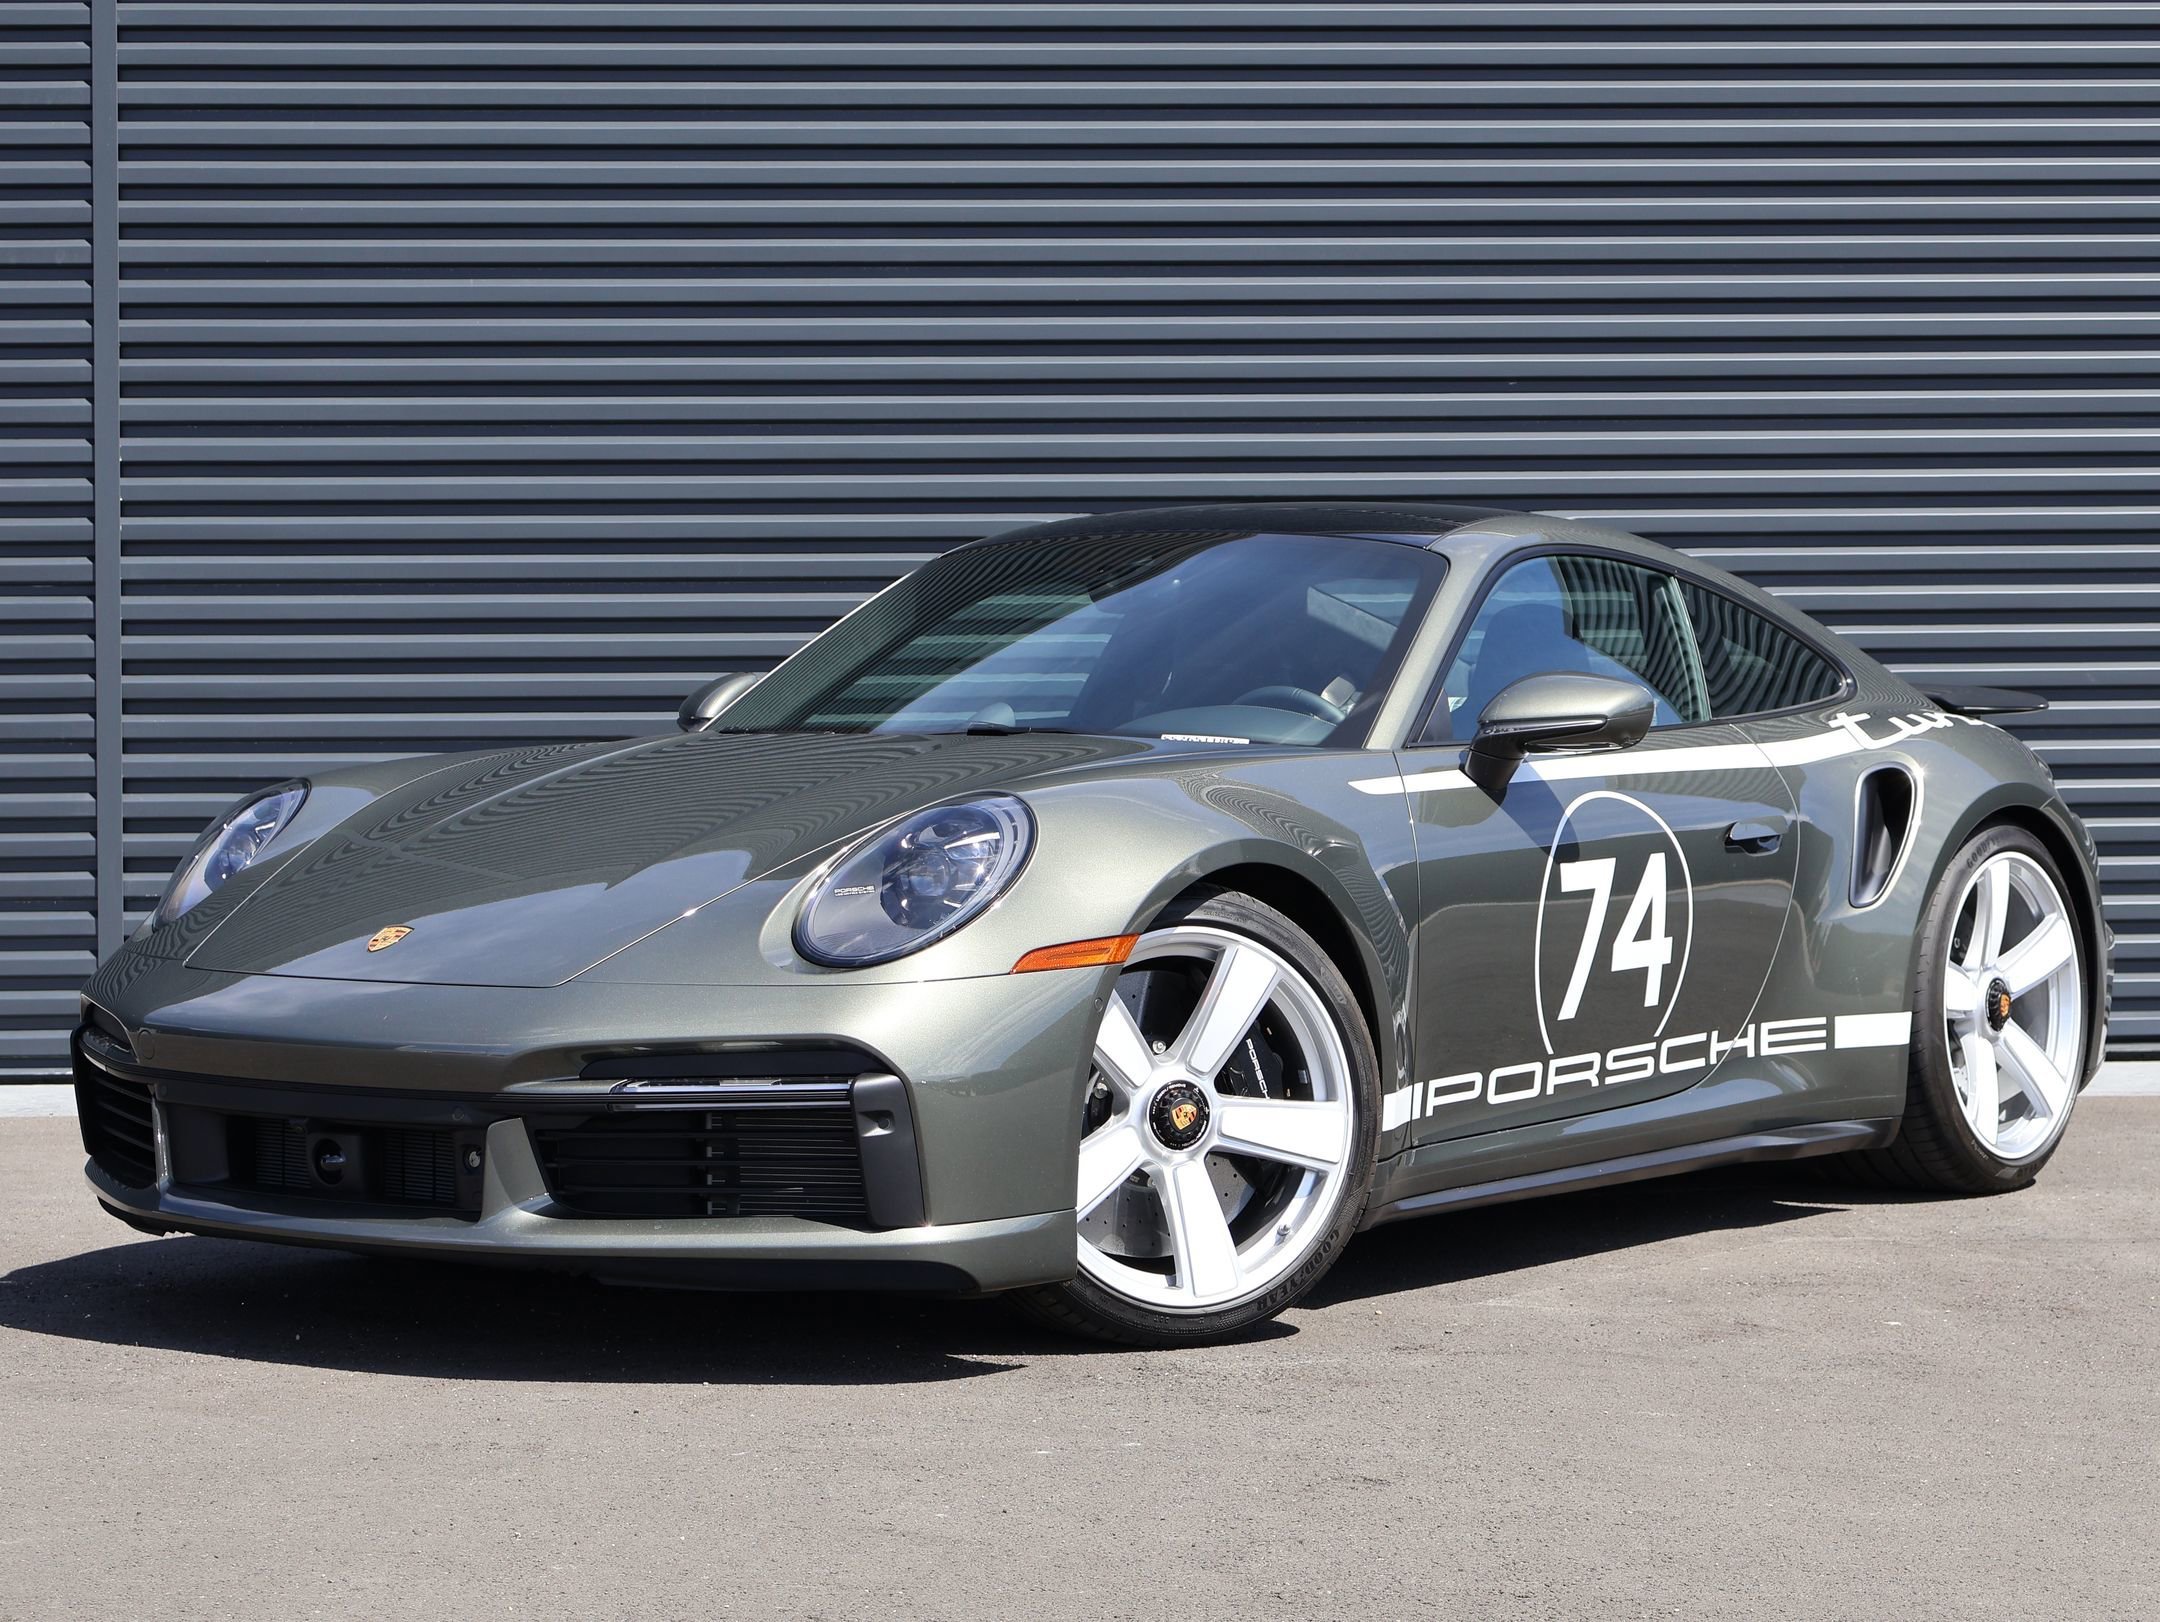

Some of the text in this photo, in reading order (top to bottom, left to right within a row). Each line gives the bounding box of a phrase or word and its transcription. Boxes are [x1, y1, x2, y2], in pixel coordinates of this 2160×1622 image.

[1556, 852, 1674, 1021] 74
[1245, 1038, 1271, 1100] PORSCH
[1425, 1016, 1827, 1117] PORSCHE
